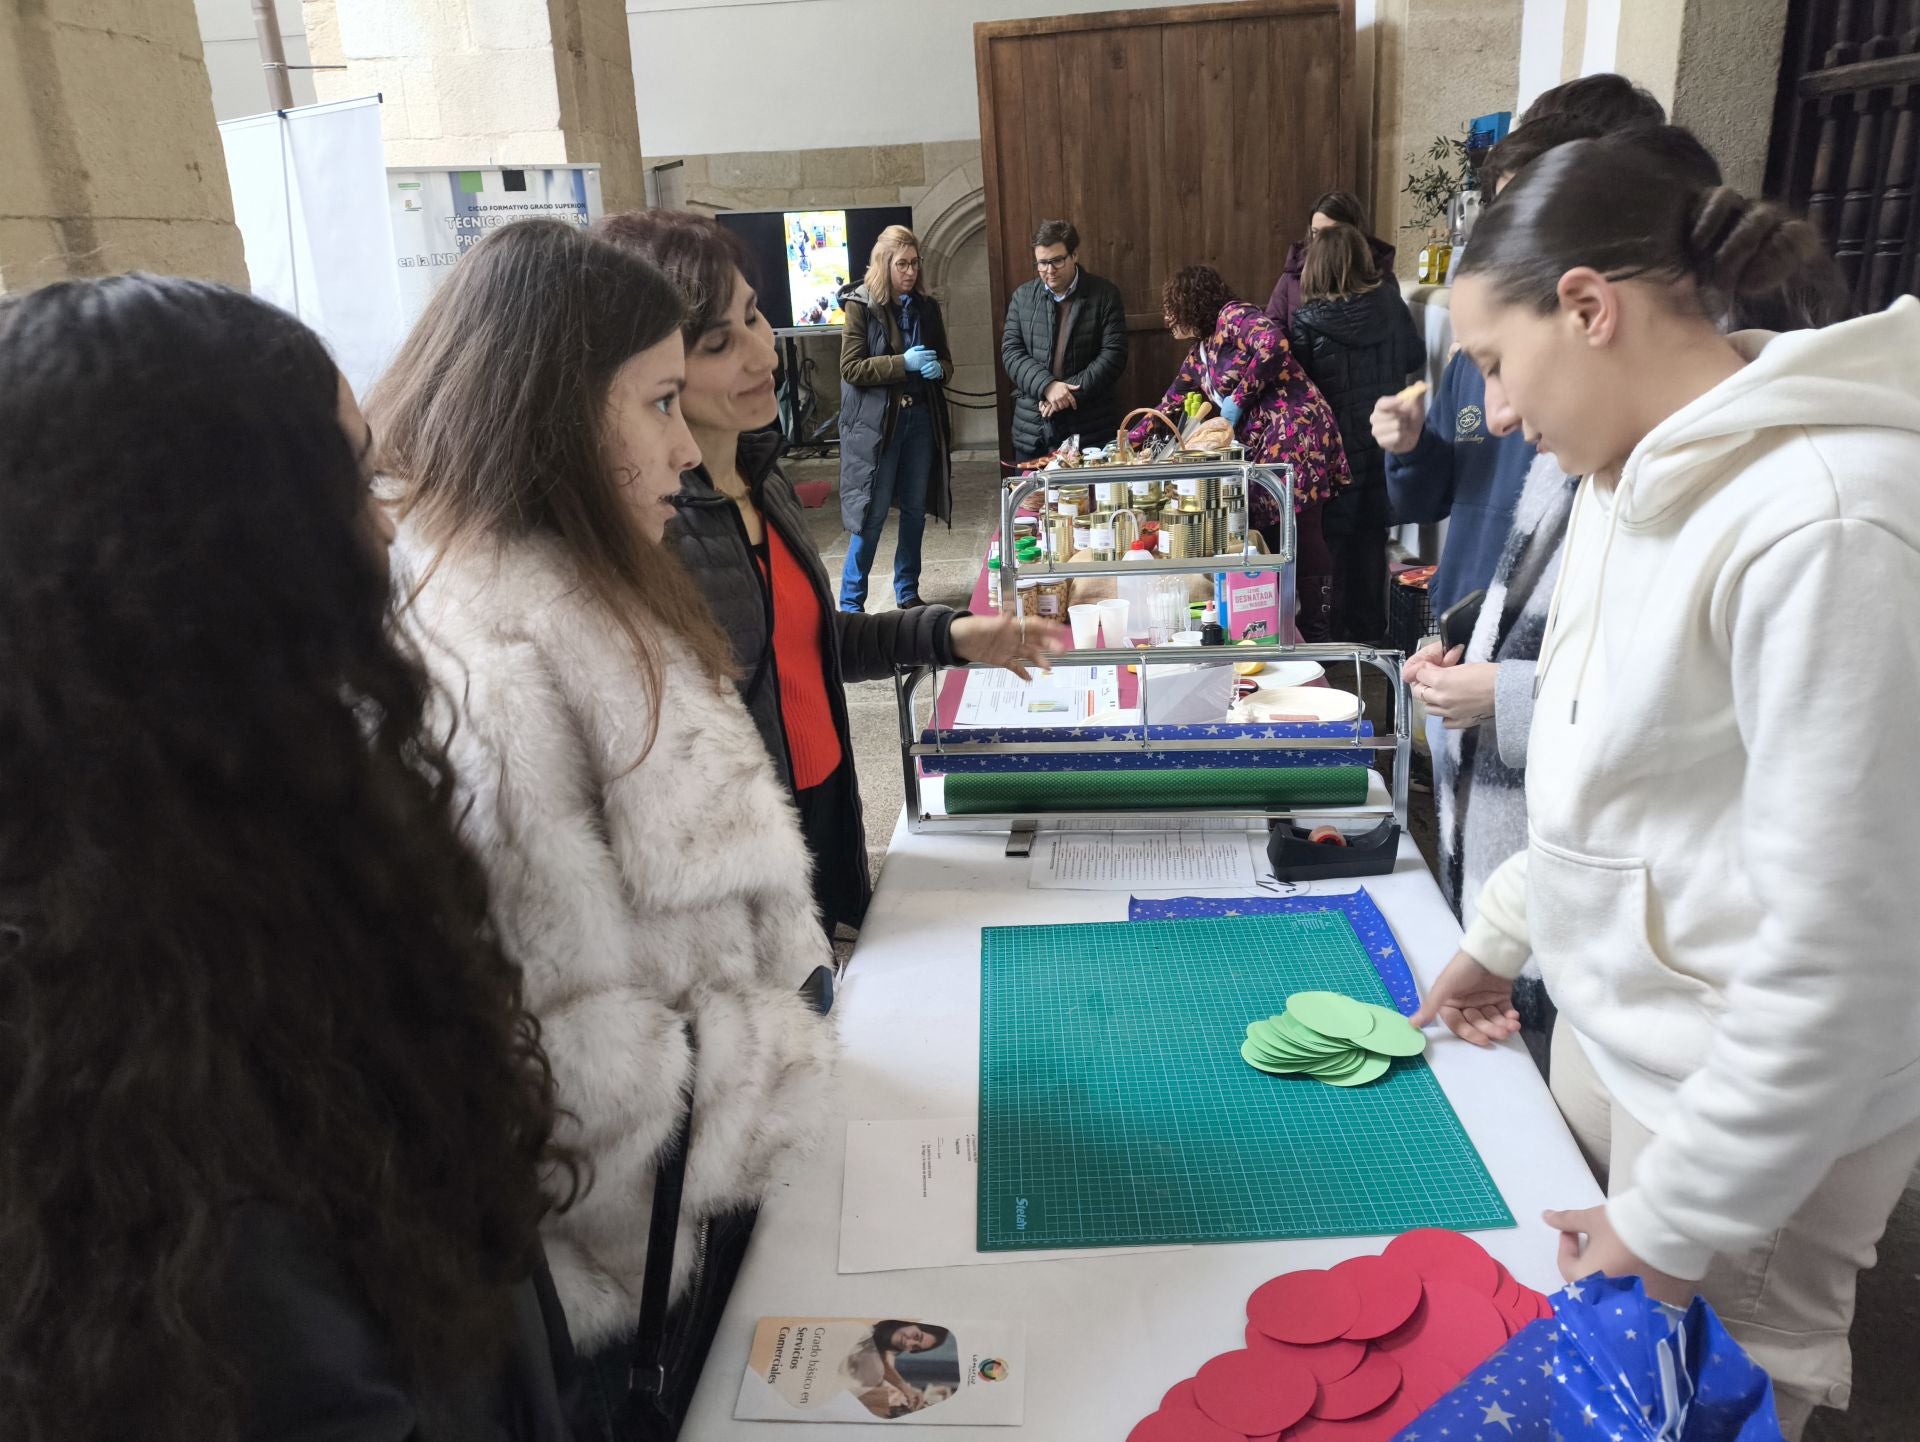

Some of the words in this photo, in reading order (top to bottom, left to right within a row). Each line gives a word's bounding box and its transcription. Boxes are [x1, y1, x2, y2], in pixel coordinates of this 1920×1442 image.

[489, 204, 529, 212] FORMATIVO
[554, 202, 586, 210] SUPERIOR
[445, 213, 505, 230] TÉCNICO
[398, 256, 415, 268] en
[417, 253, 430, 267] la
[1235, 590, 1273, 604] DESNATADA
[789, 1326, 808, 1370] Servicios
[810, 1326, 826, 1358] Grado
[767, 1325, 791, 1385] Comerciales
[803, 1359, 820, 1390] básico
[799, 1391, 810, 1404] en
